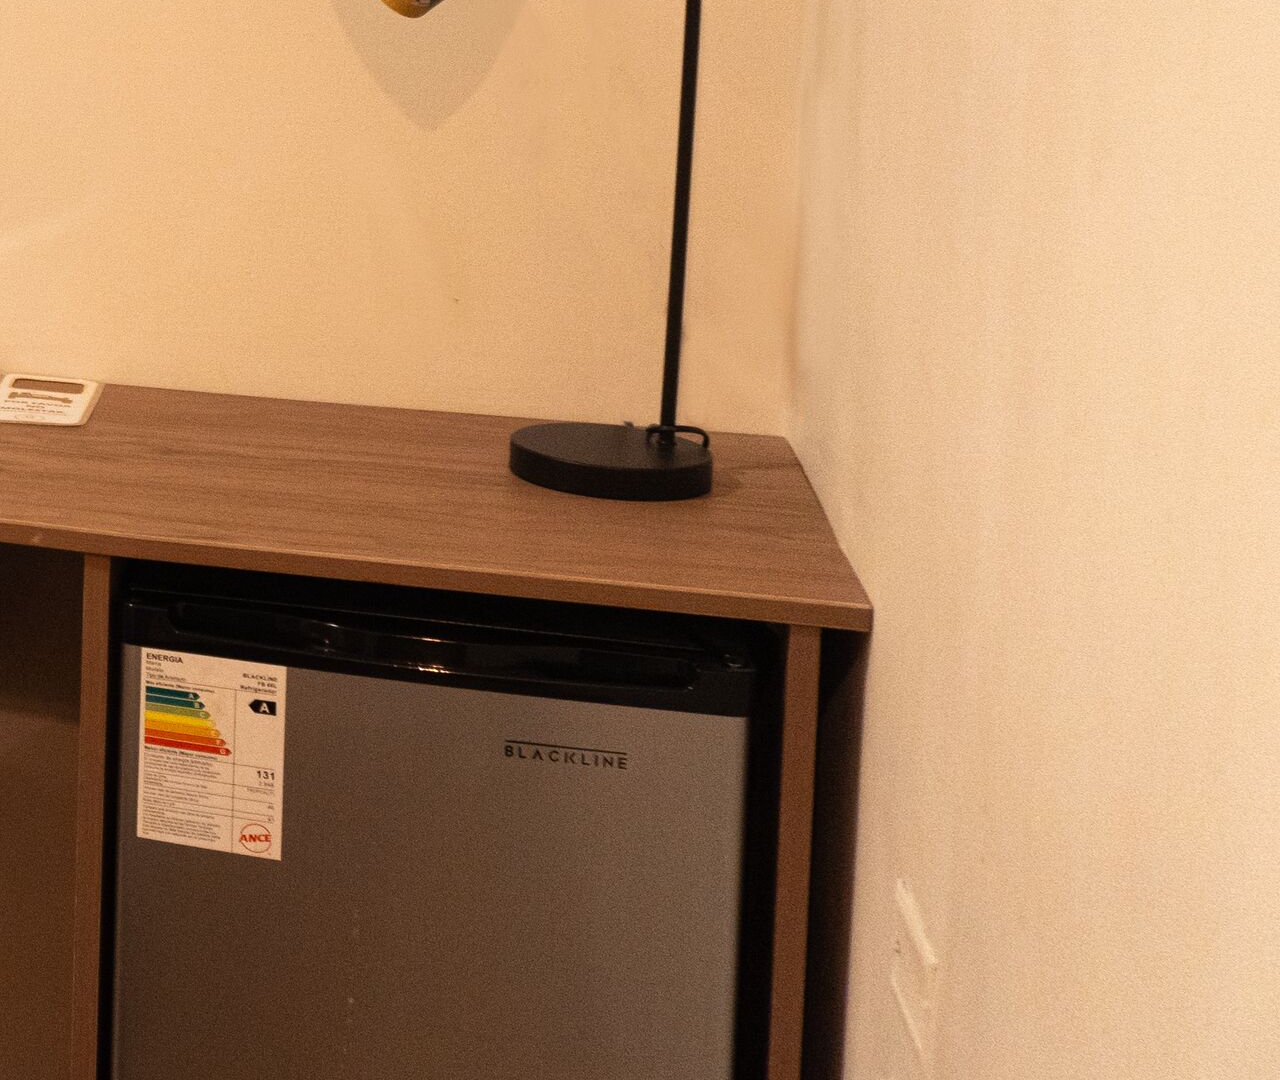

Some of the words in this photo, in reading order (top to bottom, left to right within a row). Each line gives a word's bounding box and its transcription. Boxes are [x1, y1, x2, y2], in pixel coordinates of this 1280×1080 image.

[146, 652, 184, 664] ENERGIA
[259, 702, 270, 714] A
[504, 745, 628, 770] BLACKLINE
[257, 770, 276, 781] 131
[239, 834, 272, 843] ANCE
